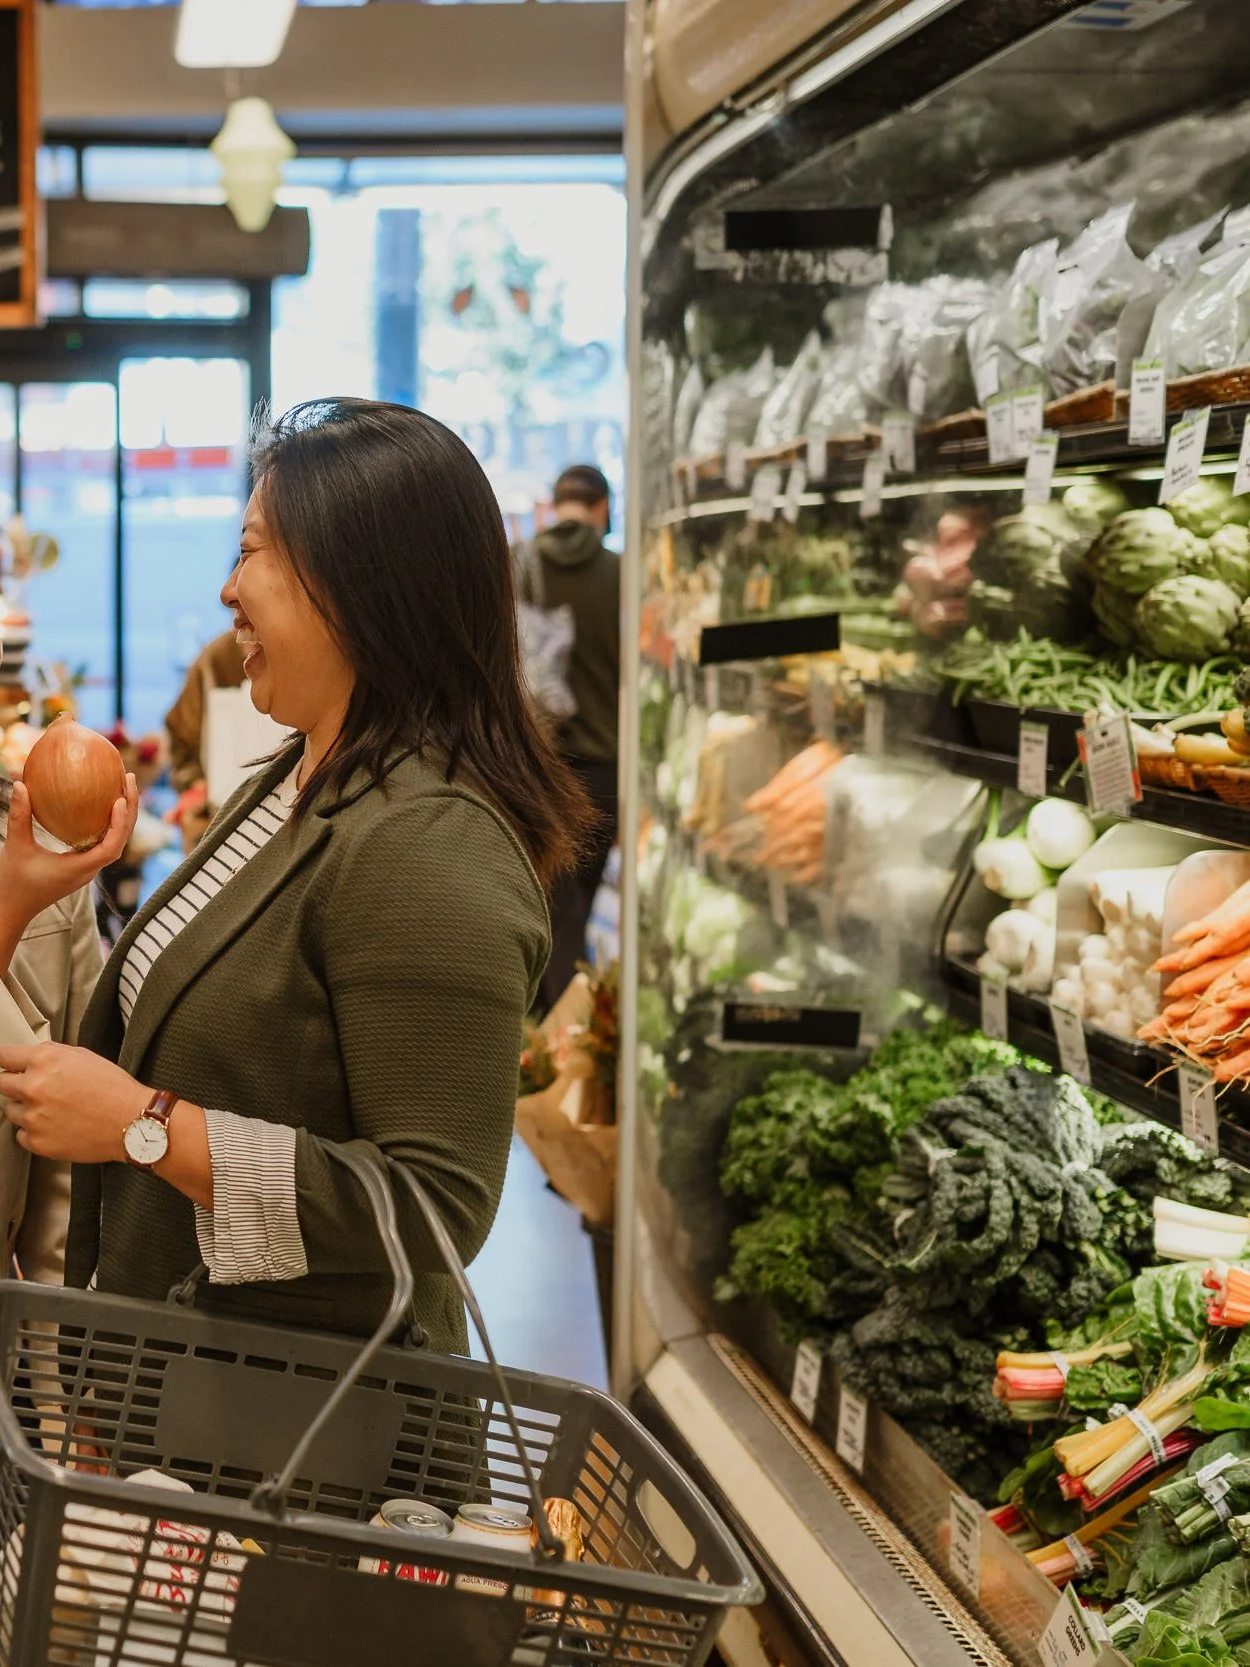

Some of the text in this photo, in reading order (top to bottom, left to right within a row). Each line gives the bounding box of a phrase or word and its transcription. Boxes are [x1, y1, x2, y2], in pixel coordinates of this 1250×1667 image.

[461, 1576, 509, 1591] AGUA FRESC
[1065, 1626, 1081, 1657] GREENS
[1068, 1614, 1086, 1651] COLLARD
